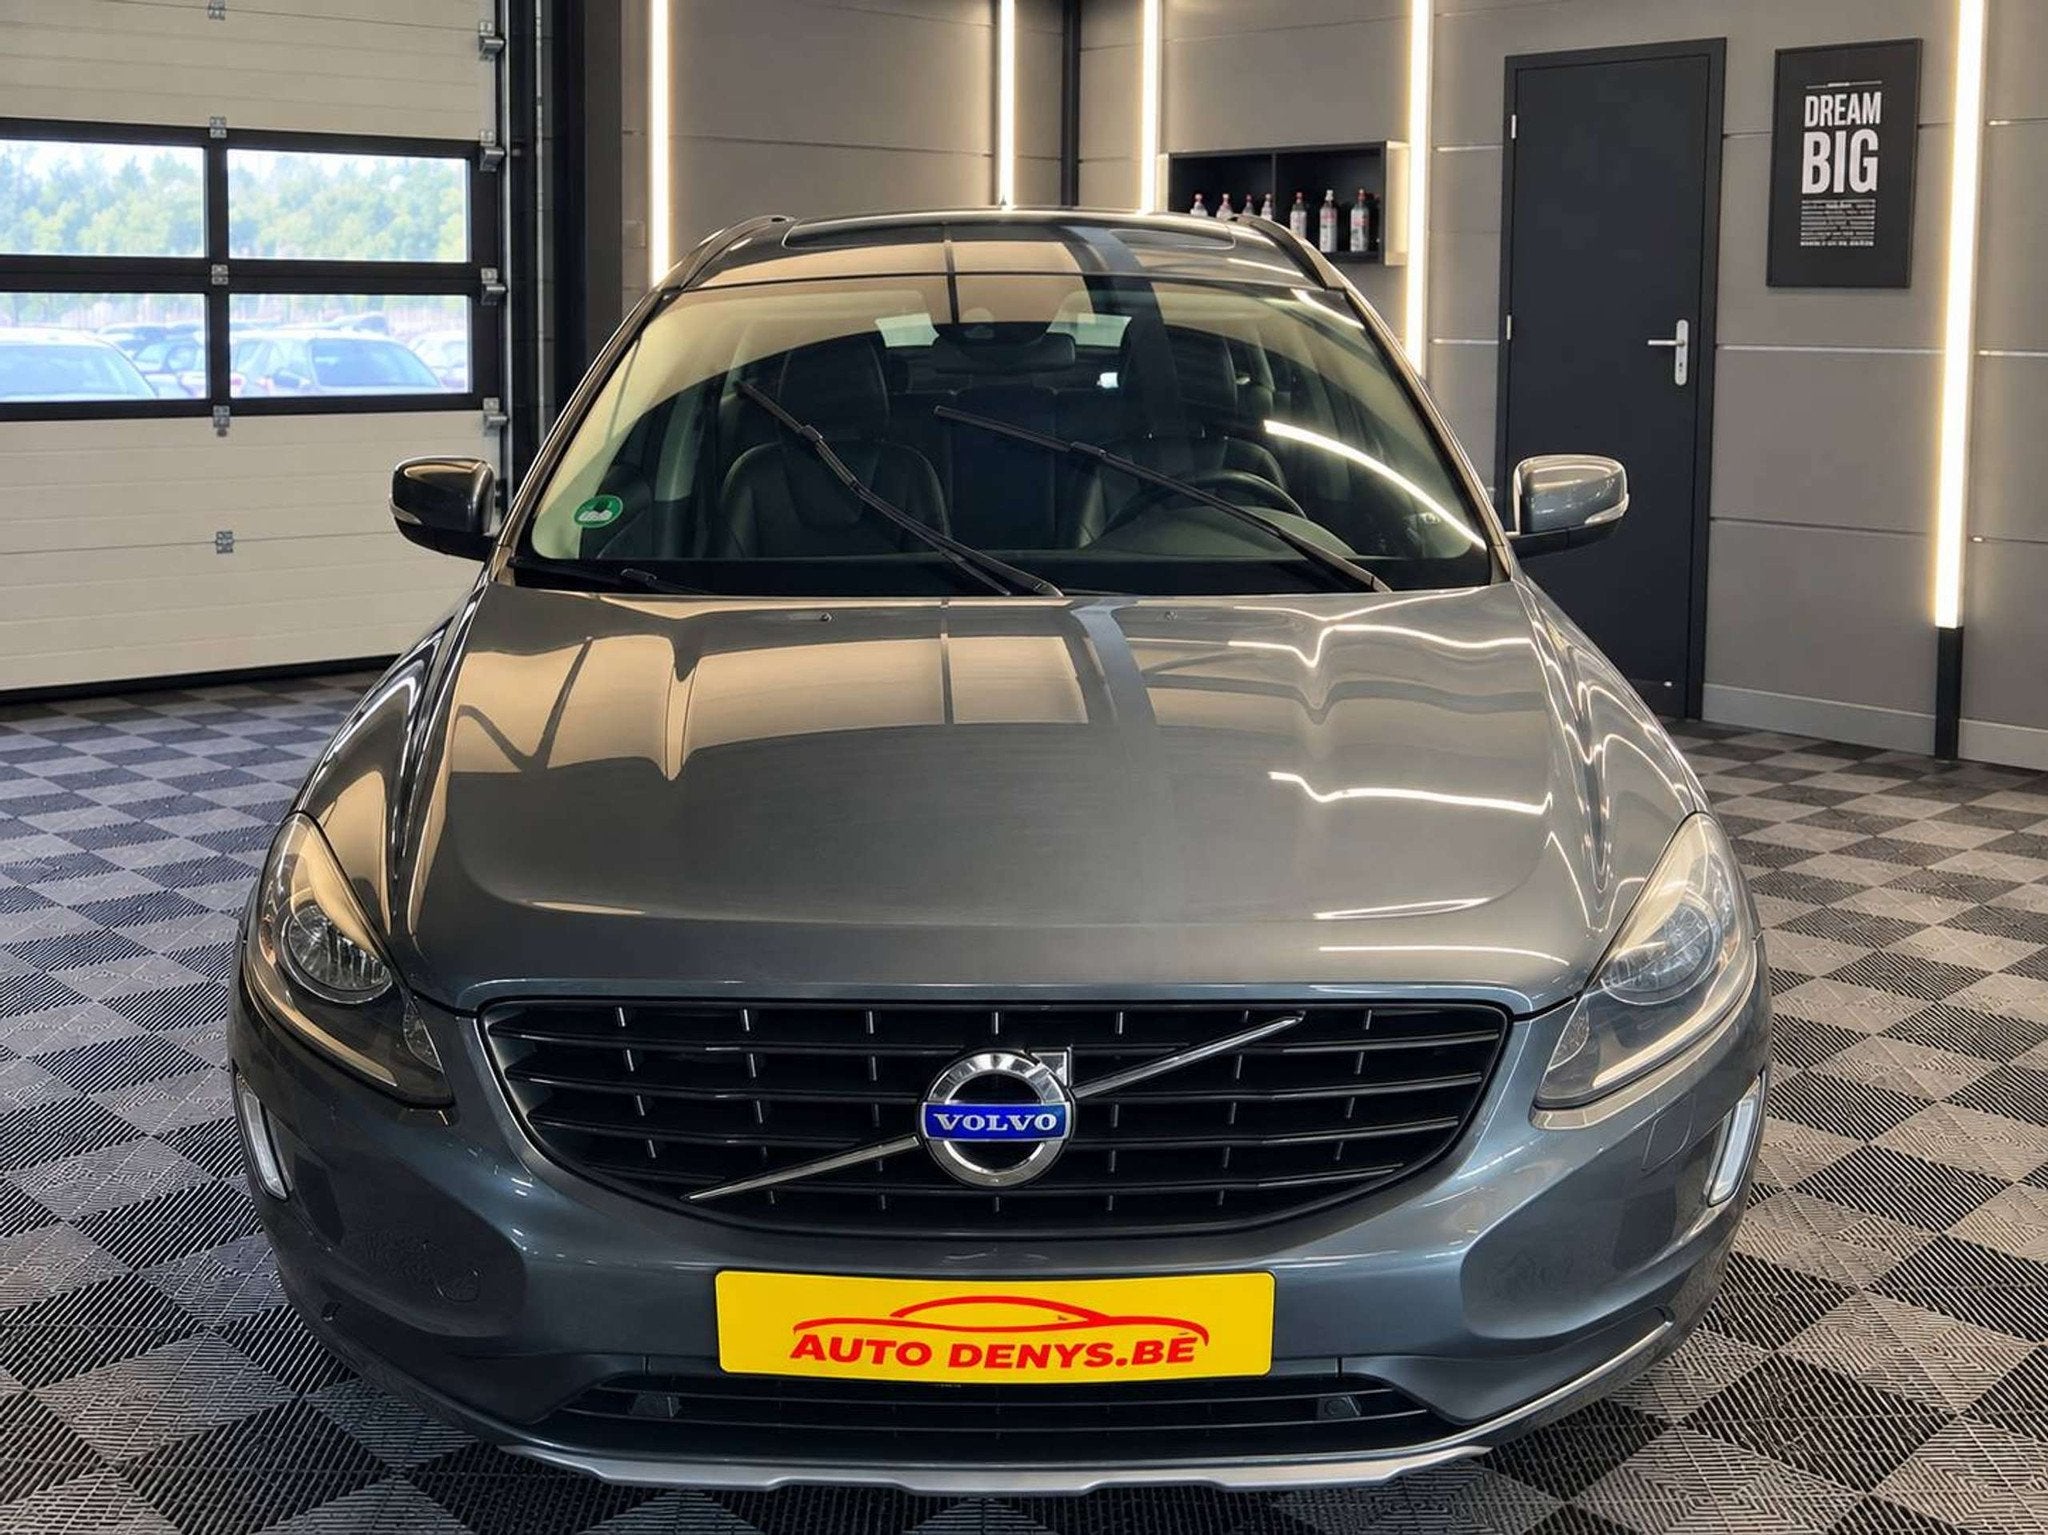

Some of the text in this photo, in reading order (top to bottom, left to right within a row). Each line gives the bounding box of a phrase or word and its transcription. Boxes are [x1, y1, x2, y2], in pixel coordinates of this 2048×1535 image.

[1804, 91, 1882, 128] DREAM
[1801, 128, 1879, 195] BIG
[932, 1112, 1059, 1132] VOLVO
[789, 1333, 933, 1367] AUTO
